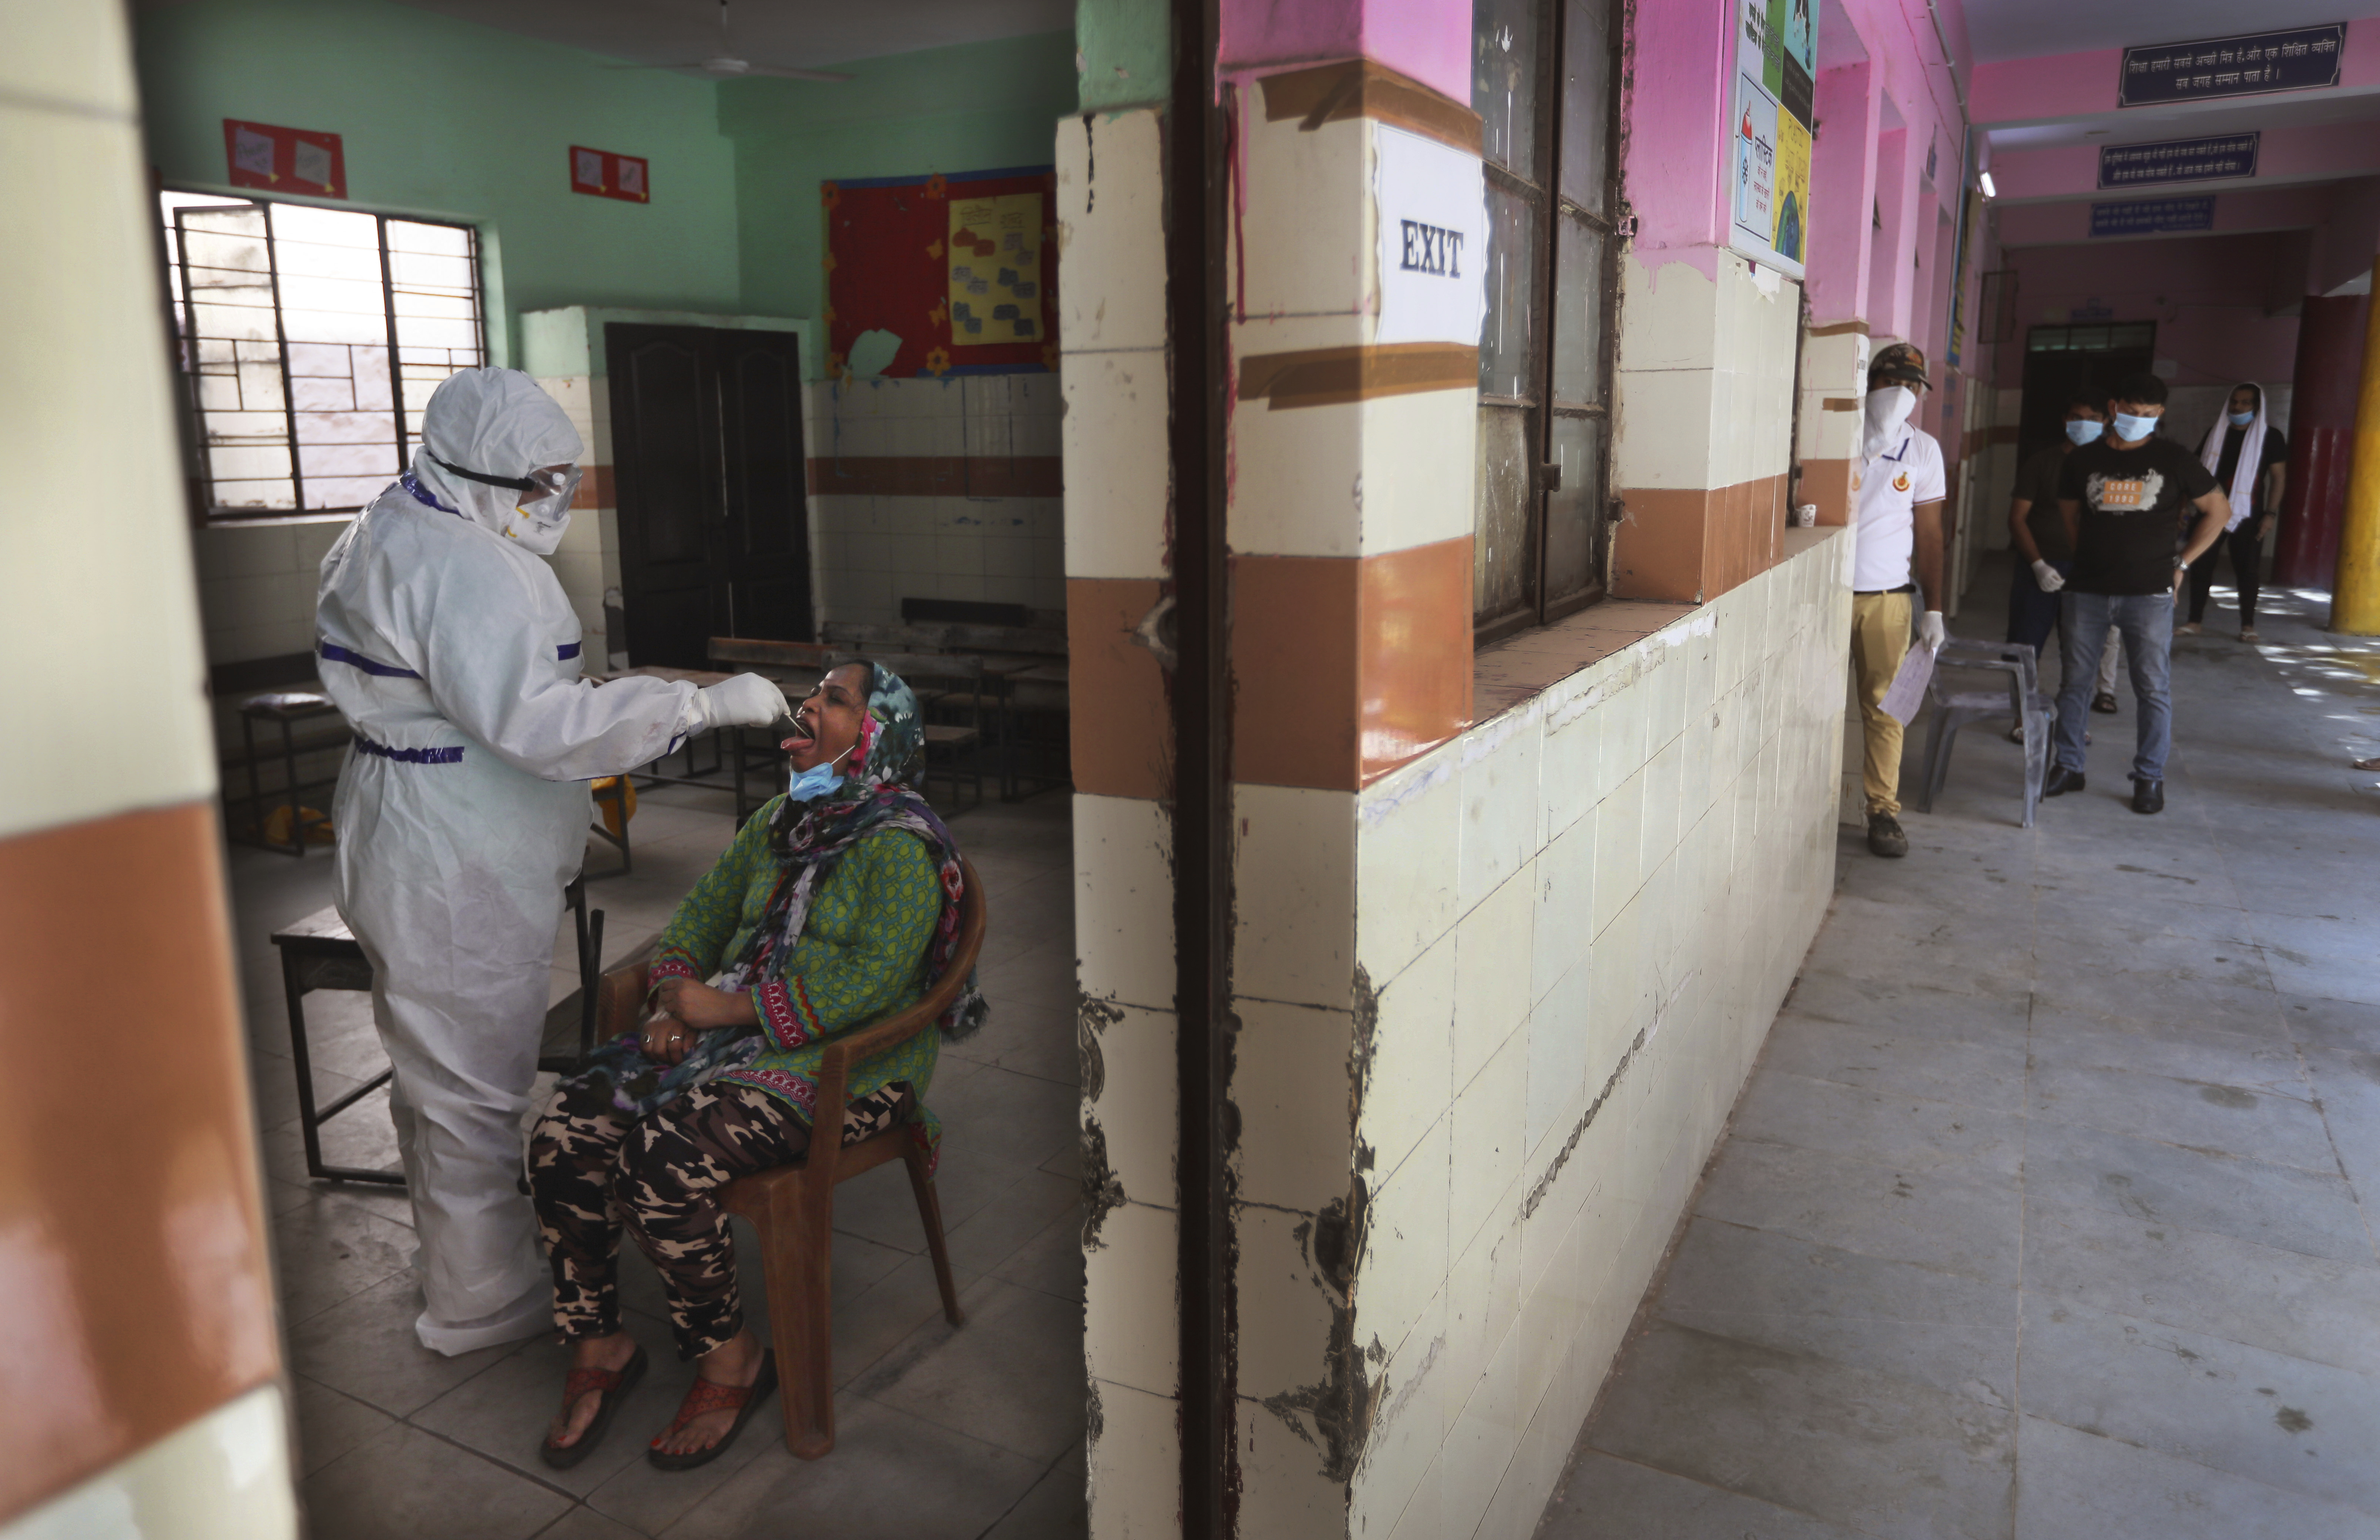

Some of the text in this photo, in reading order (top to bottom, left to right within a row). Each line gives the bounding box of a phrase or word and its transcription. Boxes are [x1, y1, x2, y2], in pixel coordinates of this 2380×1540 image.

[2129, 61, 2148, 74] शिक्षा
[2151, 57, 2170, 72] हमारी
[2173, 53, 2192, 69] सबसे
[2195, 52, 2217, 66] अच्छी
[2220, 51, 2233, 64] मित्र
[2246, 46, 2261, 61] और
[2265, 48, 2278, 61] एक
[2281, 43, 2308, 57] शिक्षित
[2311, 39, 2336, 53] व्यक्ति
[2176, 78, 2189, 90] सब
[2192, 76, 2211, 88] जगह
[2215, 73, 2240, 86] सम्मान
[2244, 71, 2260, 82] पाता
[1399, 219, 1463, 279] EXIT
[2110, 482, 2136, 491] CORE
